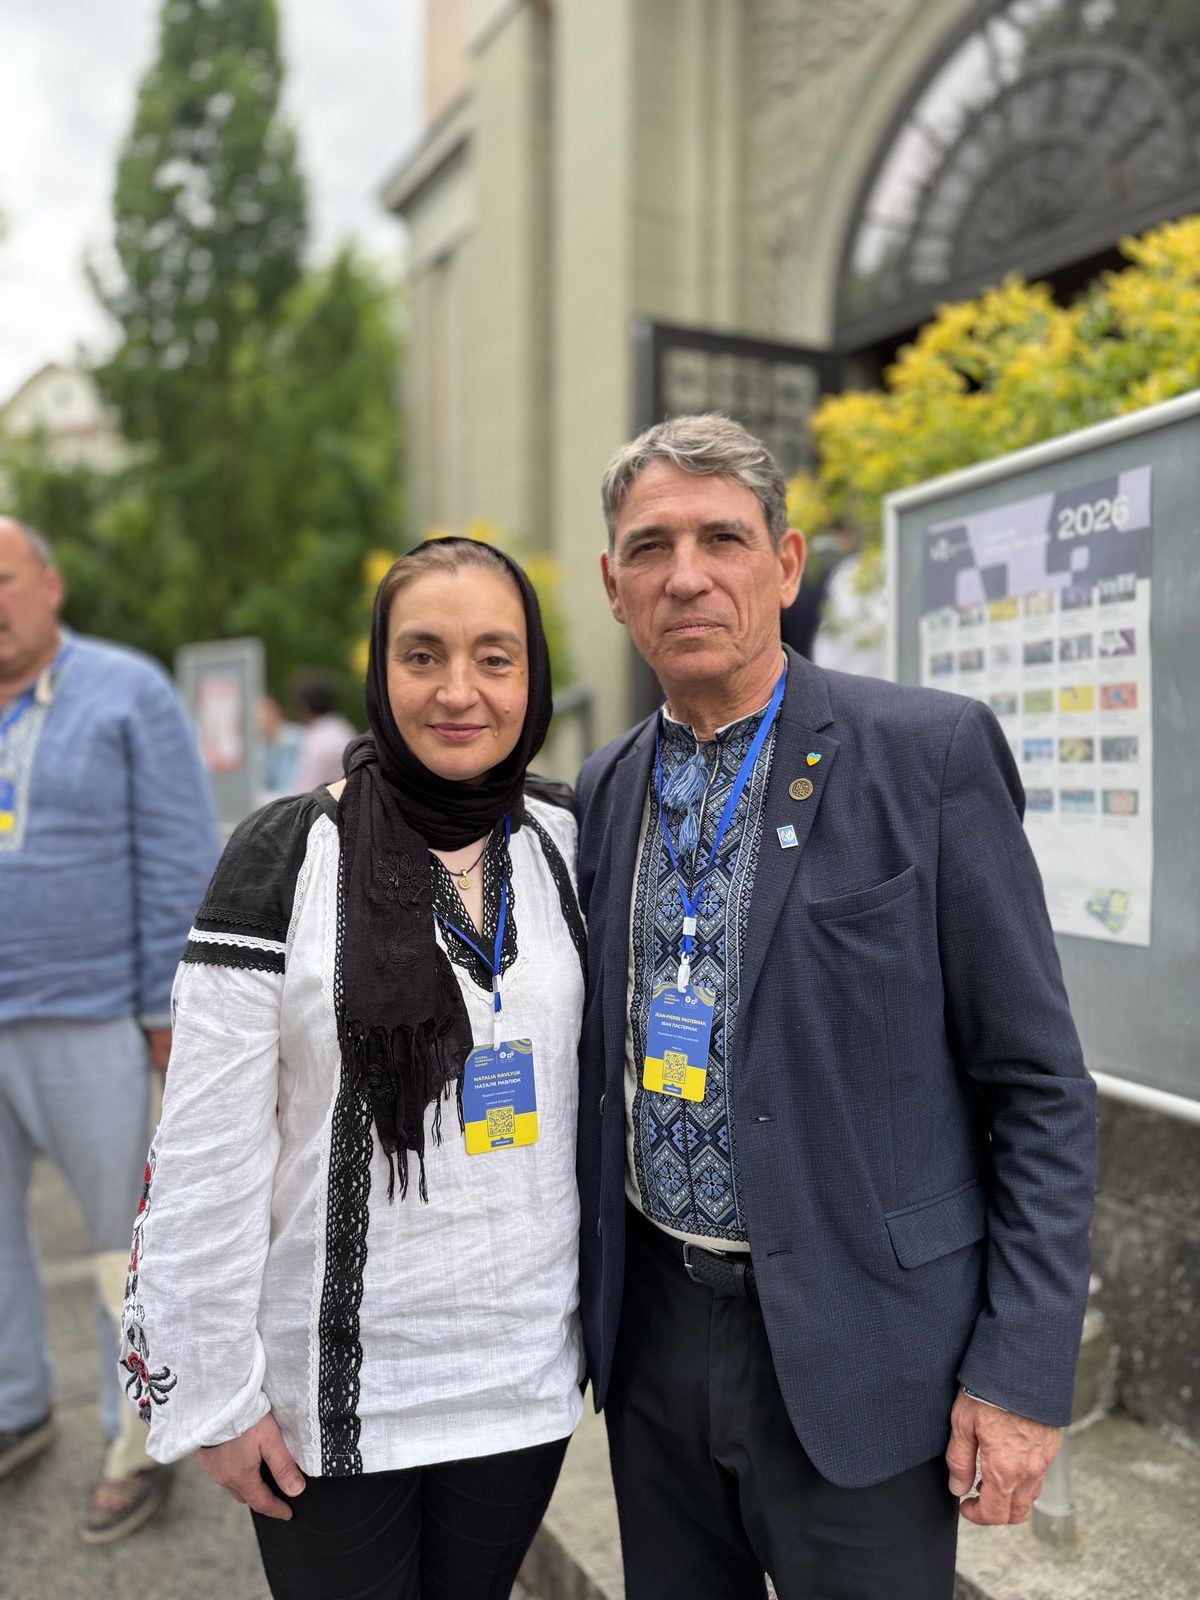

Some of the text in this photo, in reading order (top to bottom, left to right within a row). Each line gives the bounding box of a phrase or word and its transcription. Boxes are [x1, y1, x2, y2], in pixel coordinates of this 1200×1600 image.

[1057, 494, 1129, 541] 2026
[473, 1070, 521, 1082] NATALIA RAVLYUK
[498, 1078, 521, 1086] РАВЛЮК
